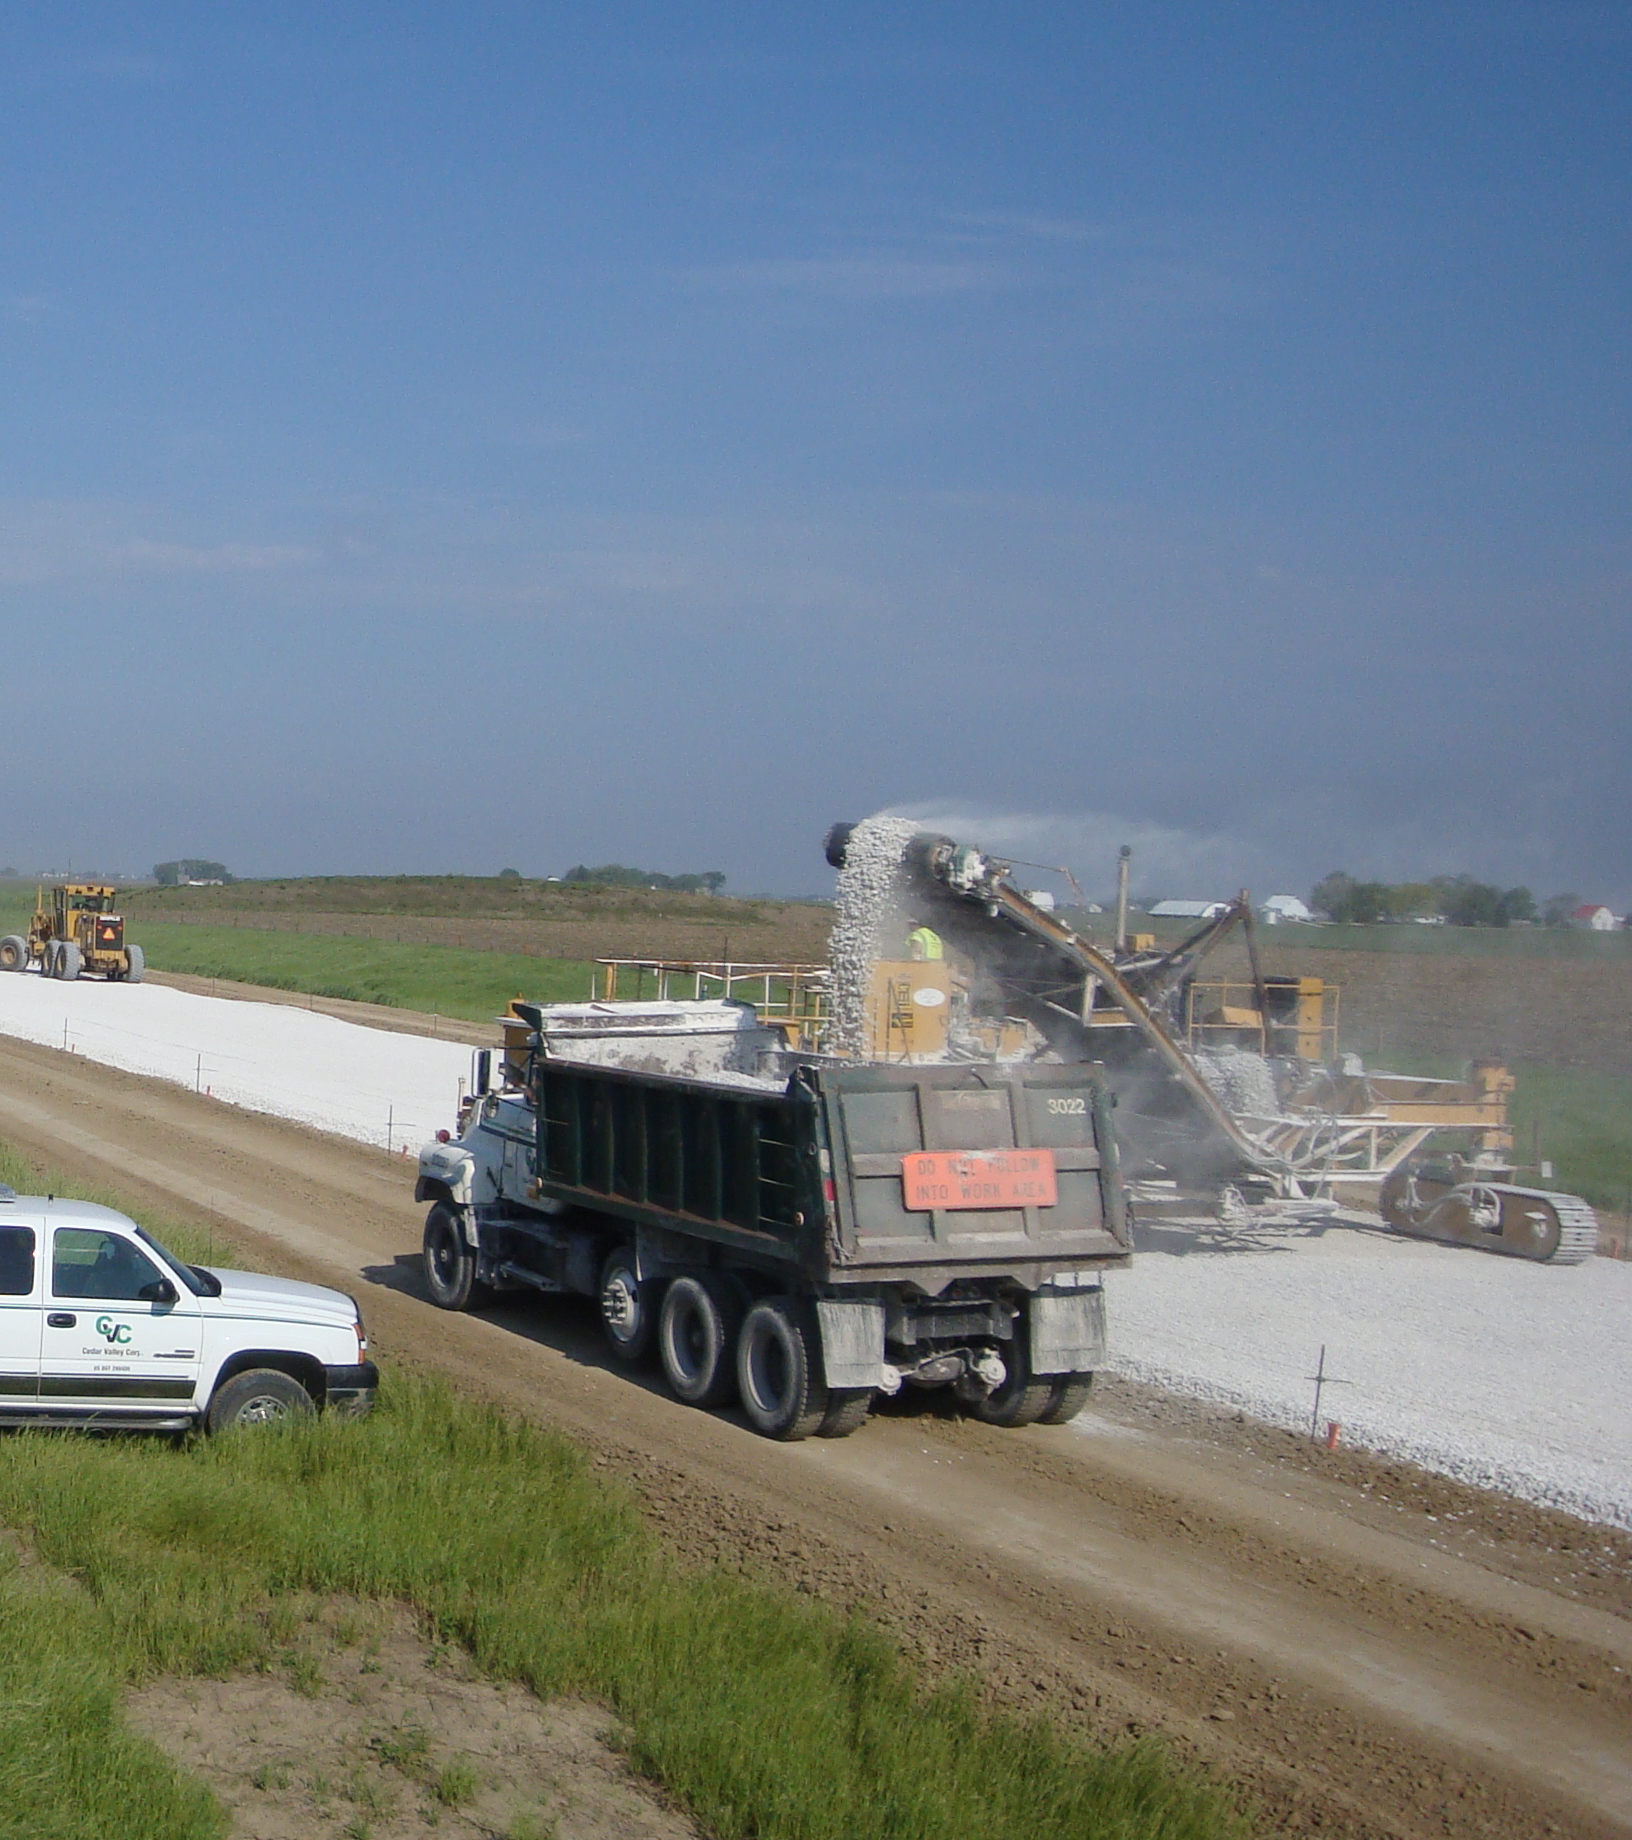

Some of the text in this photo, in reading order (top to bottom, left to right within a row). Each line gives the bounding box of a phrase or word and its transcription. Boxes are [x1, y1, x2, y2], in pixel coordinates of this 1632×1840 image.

[1048, 1098, 1086, 1115] 3022
[917, 1160, 936, 1175] DO
[988, 1157, 1040, 1173] FOLLOW
[916, 1182, 1045, 1200] INTO WORK AREA
[96, 1315, 132, 1343] CVC
[82, 1347, 102, 1355] Cedar
[104, 1347, 124, 1357] Valley
